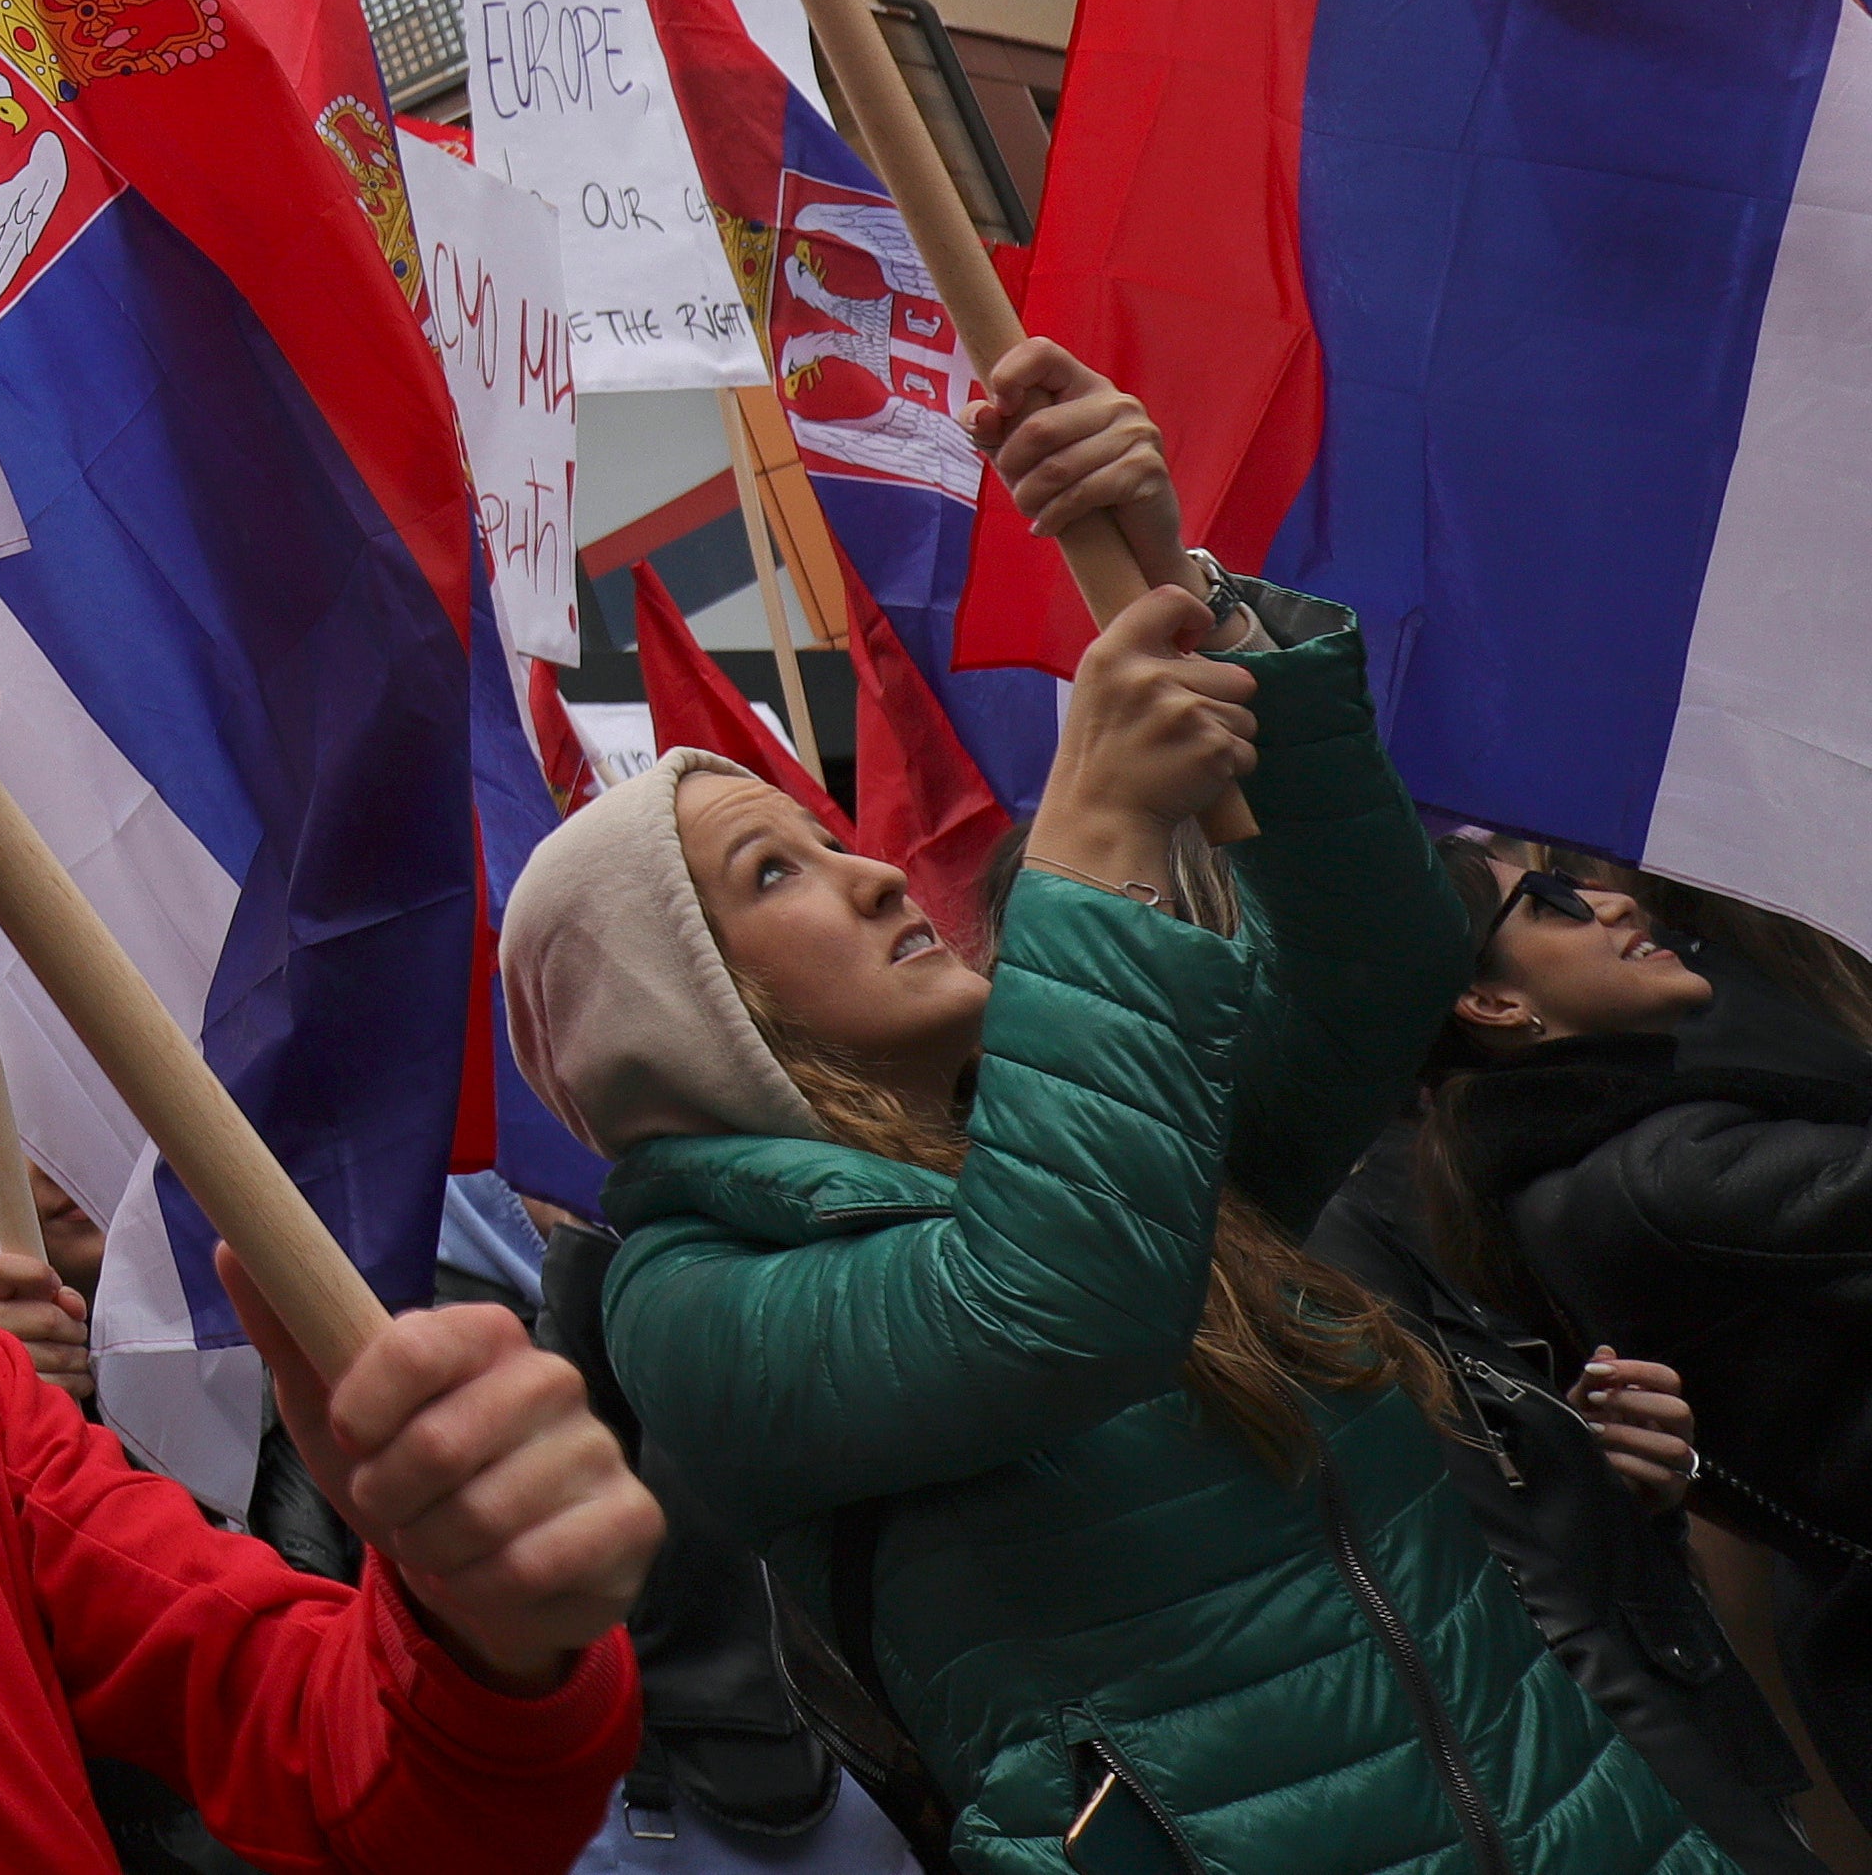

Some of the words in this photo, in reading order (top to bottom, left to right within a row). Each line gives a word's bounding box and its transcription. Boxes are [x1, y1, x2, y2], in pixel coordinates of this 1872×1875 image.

[482, 0, 651, 120] EUROPE,
[581, 182, 665, 234] OUR
[596, 308, 663, 346] THE
